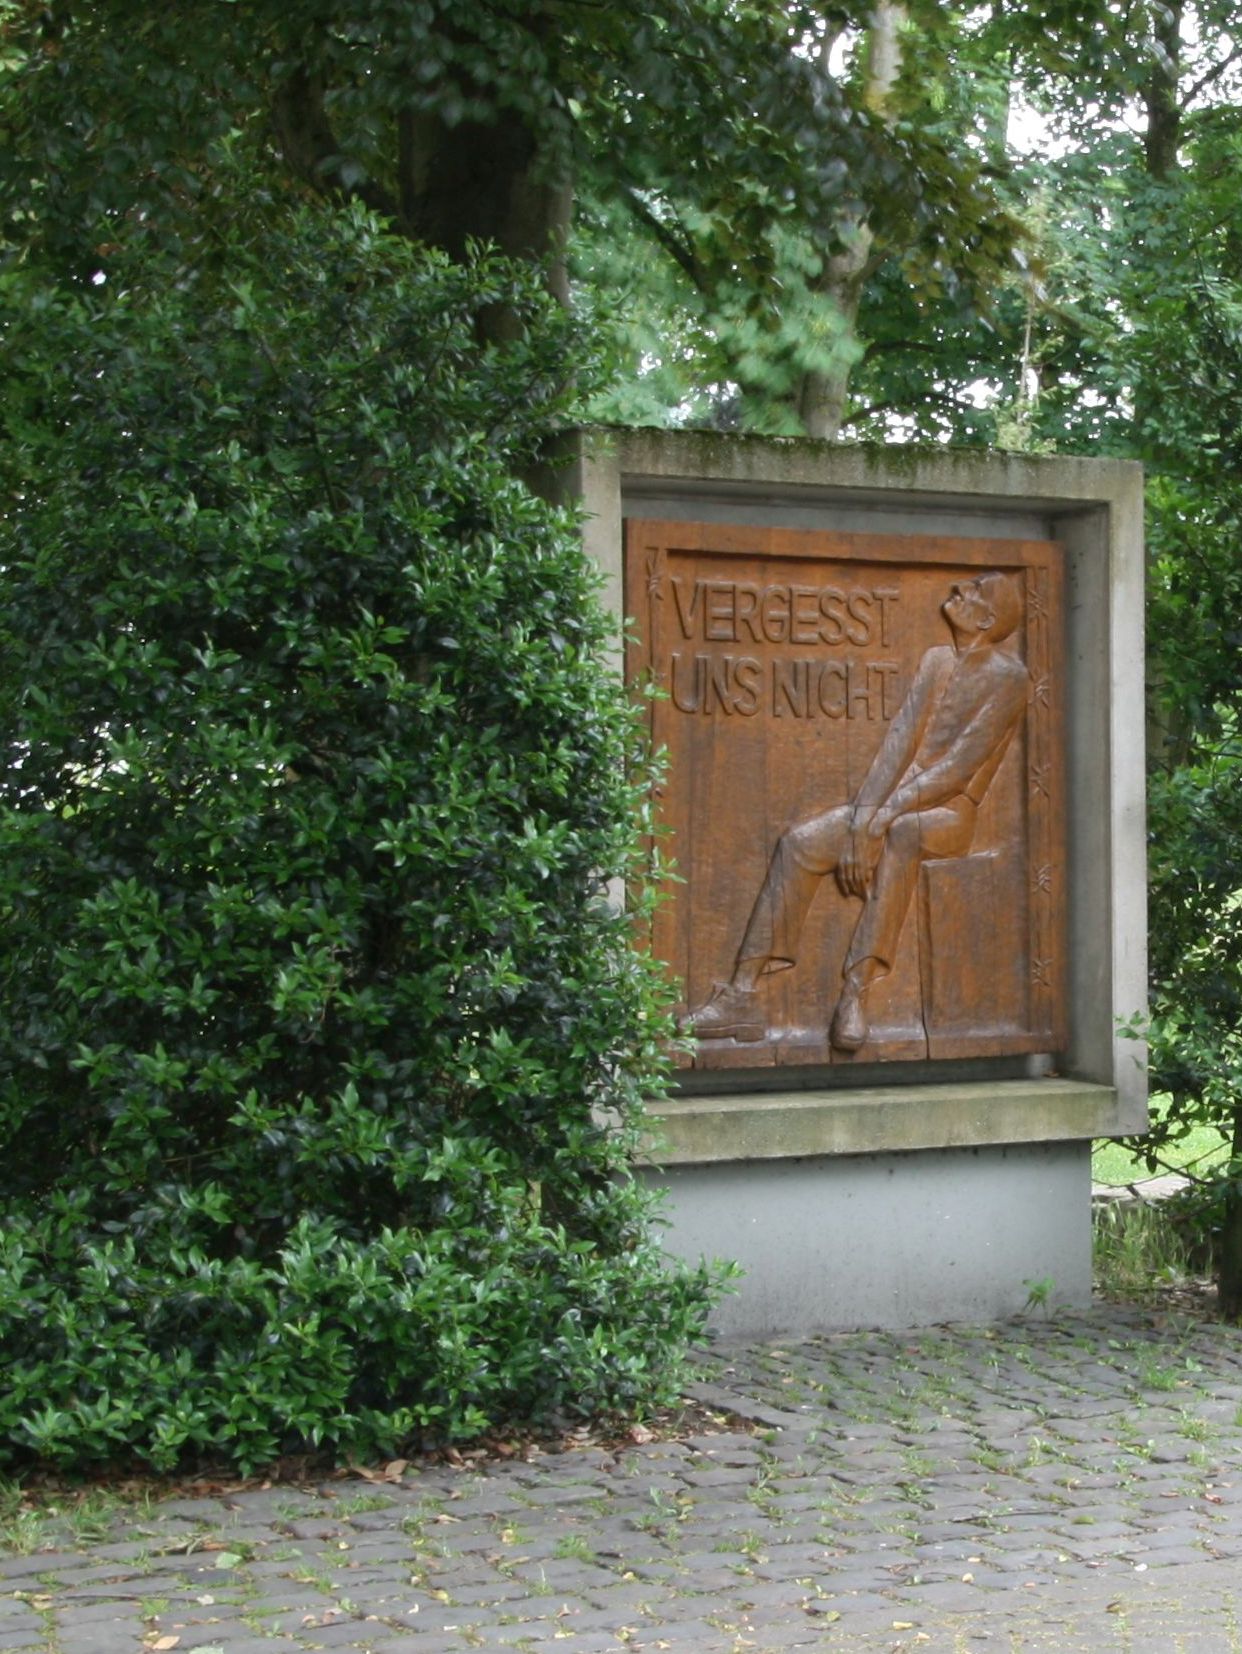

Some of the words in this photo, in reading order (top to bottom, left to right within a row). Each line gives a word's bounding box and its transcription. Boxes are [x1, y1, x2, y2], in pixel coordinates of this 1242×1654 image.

[671, 576, 900, 648] VERGESST
[670, 651, 762, 717] UNS
[771, 657, 900, 721] NICHT
